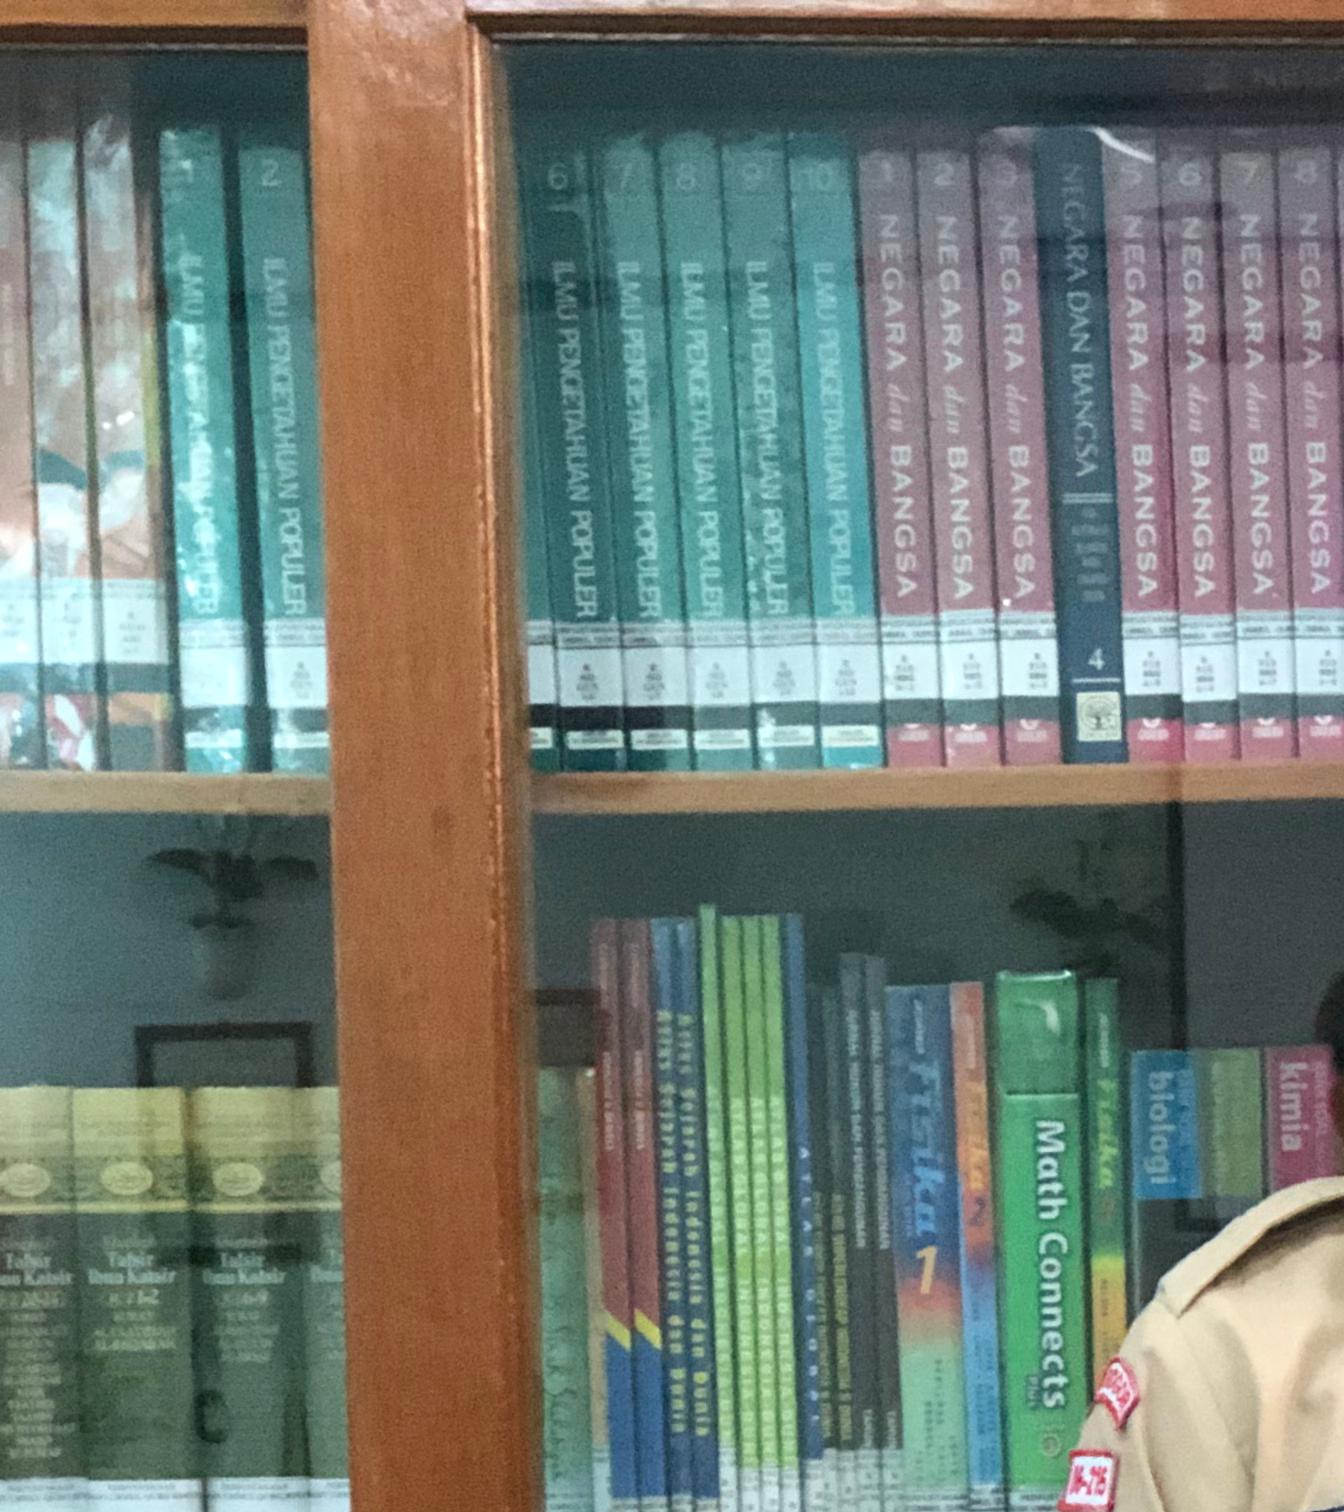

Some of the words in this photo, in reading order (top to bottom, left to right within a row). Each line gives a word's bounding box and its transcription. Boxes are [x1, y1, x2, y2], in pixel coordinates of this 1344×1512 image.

[1060, 164, 1089, 281] NEGARA
[552, 261, 576, 320] ILMU
[617, 262, 642, 322] ILMU
[681, 262, 704, 322] ILMU
[813, 262, 836, 322] ILMU
[878, 213, 907, 371] NEGARA
[935, 215, 963, 373] NEGARA
[998, 214, 1025, 372] NEGARA
[1066, 290, 1092, 352] DAN
[1121, 214, 1150, 370] NEGARA
[1180, 216, 1207, 373] NEGARA
[1238, 213, 1266, 370] NEGARA
[1298, 211, 1323, 370] NEGARA
[558, 328, 590, 500] PENGETAHUAN
[622, 328, 654, 500] PENGETAHUAN
[686, 329, 717, 500] PENGETAHUAN
[816, 329, 847, 500] PENGETAHUAN
[887, 383, 910, 433] dan
[943, 384, 967, 435] dan
[1005, 383, 1028, 435] dan
[1069, 363, 1098, 477] BANGSA
[1128, 382, 1150, 433] dan
[1187, 383, 1209, 434] dan
[1245, 380, 1267, 432] dan
[1303, 379, 1326, 431] dan
[570, 510, 598, 617] POPULER
[634, 510, 662, 617] POPULER
[699, 510, 724, 617] POPULER
[829, 509, 854, 615] POPULER
[890, 444, 917, 598] BANGSA
[946, 446, 973, 599] BANGSA
[1008, 445, 1034, 598] BANGSA
[1131, 444, 1158, 597] BANGSA
[1189, 445, 1215, 597] BANGSA
[1247, 442, 1274, 595] BANGSA
[1305, 441, 1330, 594] BANGSA
[1087, 648, 1105, 671] 4
[1144, 1071, 1177, 1184] biologi
[1280, 1062, 1309, 1152] kimia
[1035, 1120, 1068, 1219] Math
[916, 1246, 938, 1294] 1
[1039, 1232, 1070, 1408] Connects
